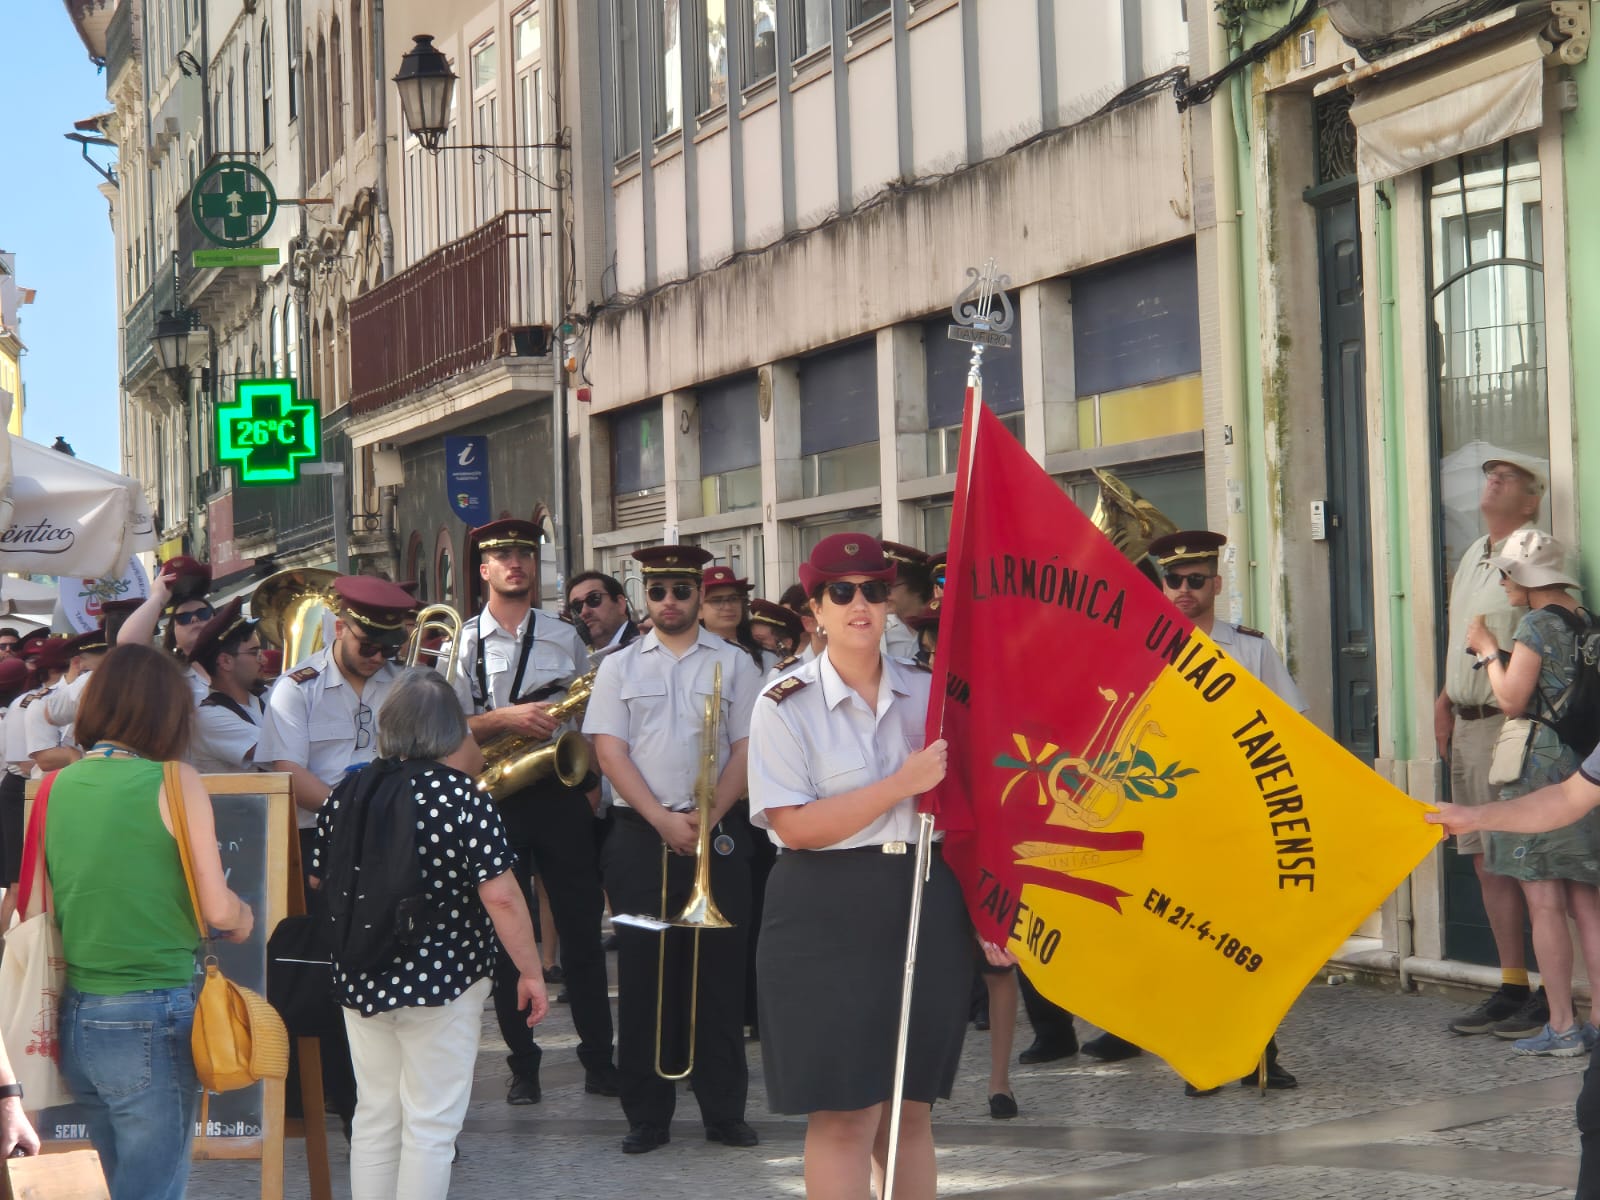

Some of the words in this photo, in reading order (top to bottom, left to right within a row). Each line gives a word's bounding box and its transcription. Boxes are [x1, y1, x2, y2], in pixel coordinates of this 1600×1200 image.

[1145, 613, 1237, 703] UNIÃO
[1232, 708, 1316, 893] TAVEIRENSE
[975, 868, 1062, 965] TAVEIRO
[1143, 887, 1172, 918] EM
[1167, 905, 1264, 973] 21-4-1869
[55, 1123, 89, 1139] SERV
